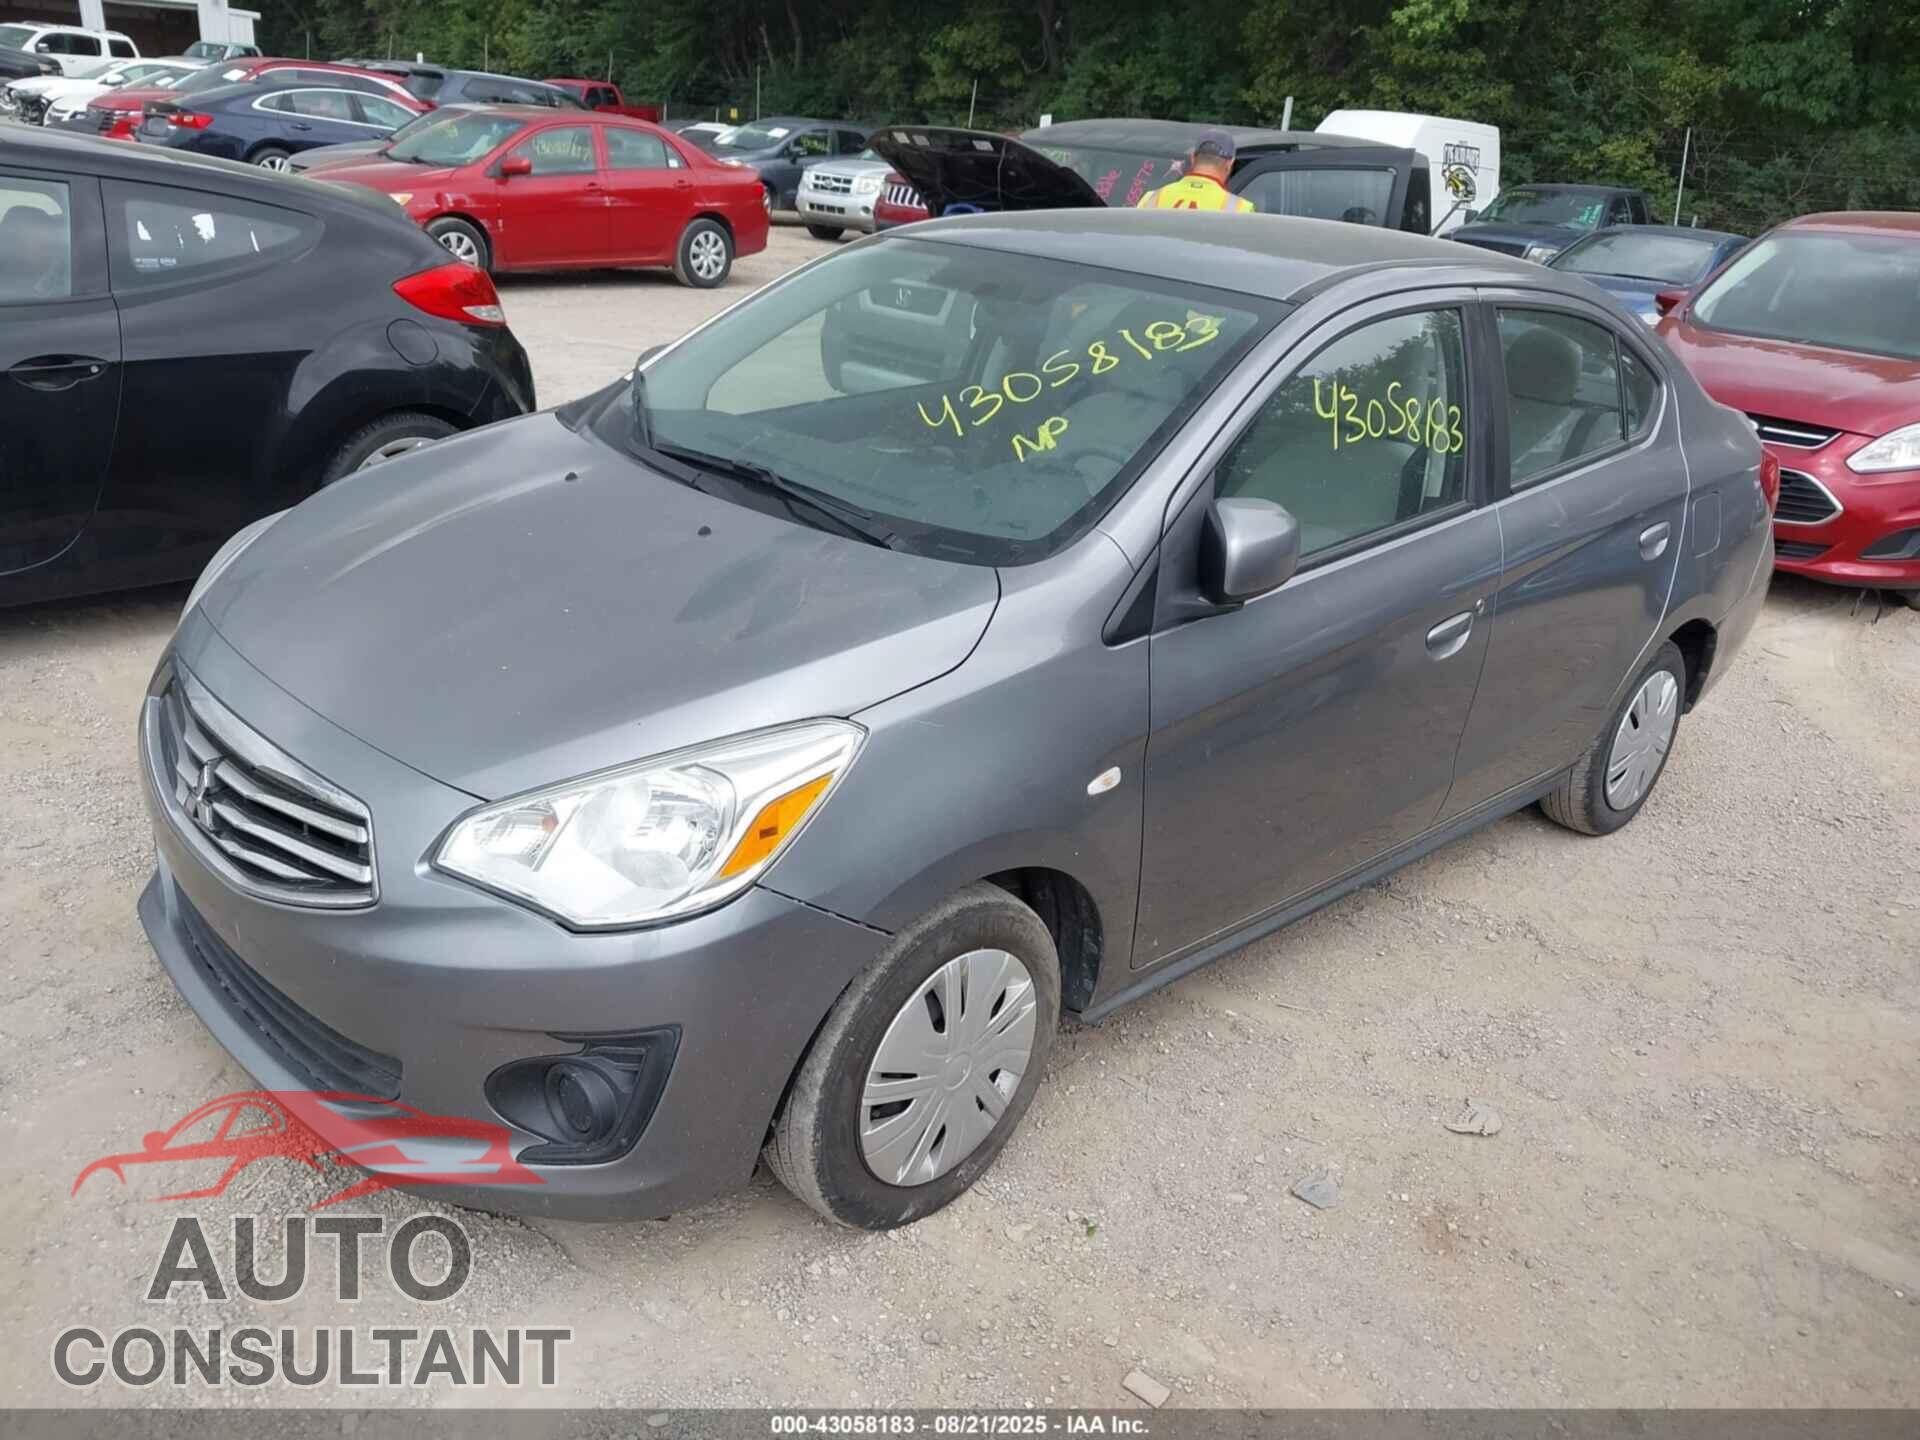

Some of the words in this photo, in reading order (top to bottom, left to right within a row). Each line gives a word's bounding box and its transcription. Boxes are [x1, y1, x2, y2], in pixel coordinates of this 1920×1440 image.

[917, 315, 1221, 436] 43058183
[1011, 416, 1069, 462] NP
[1313, 377, 1464, 453] 43058183
